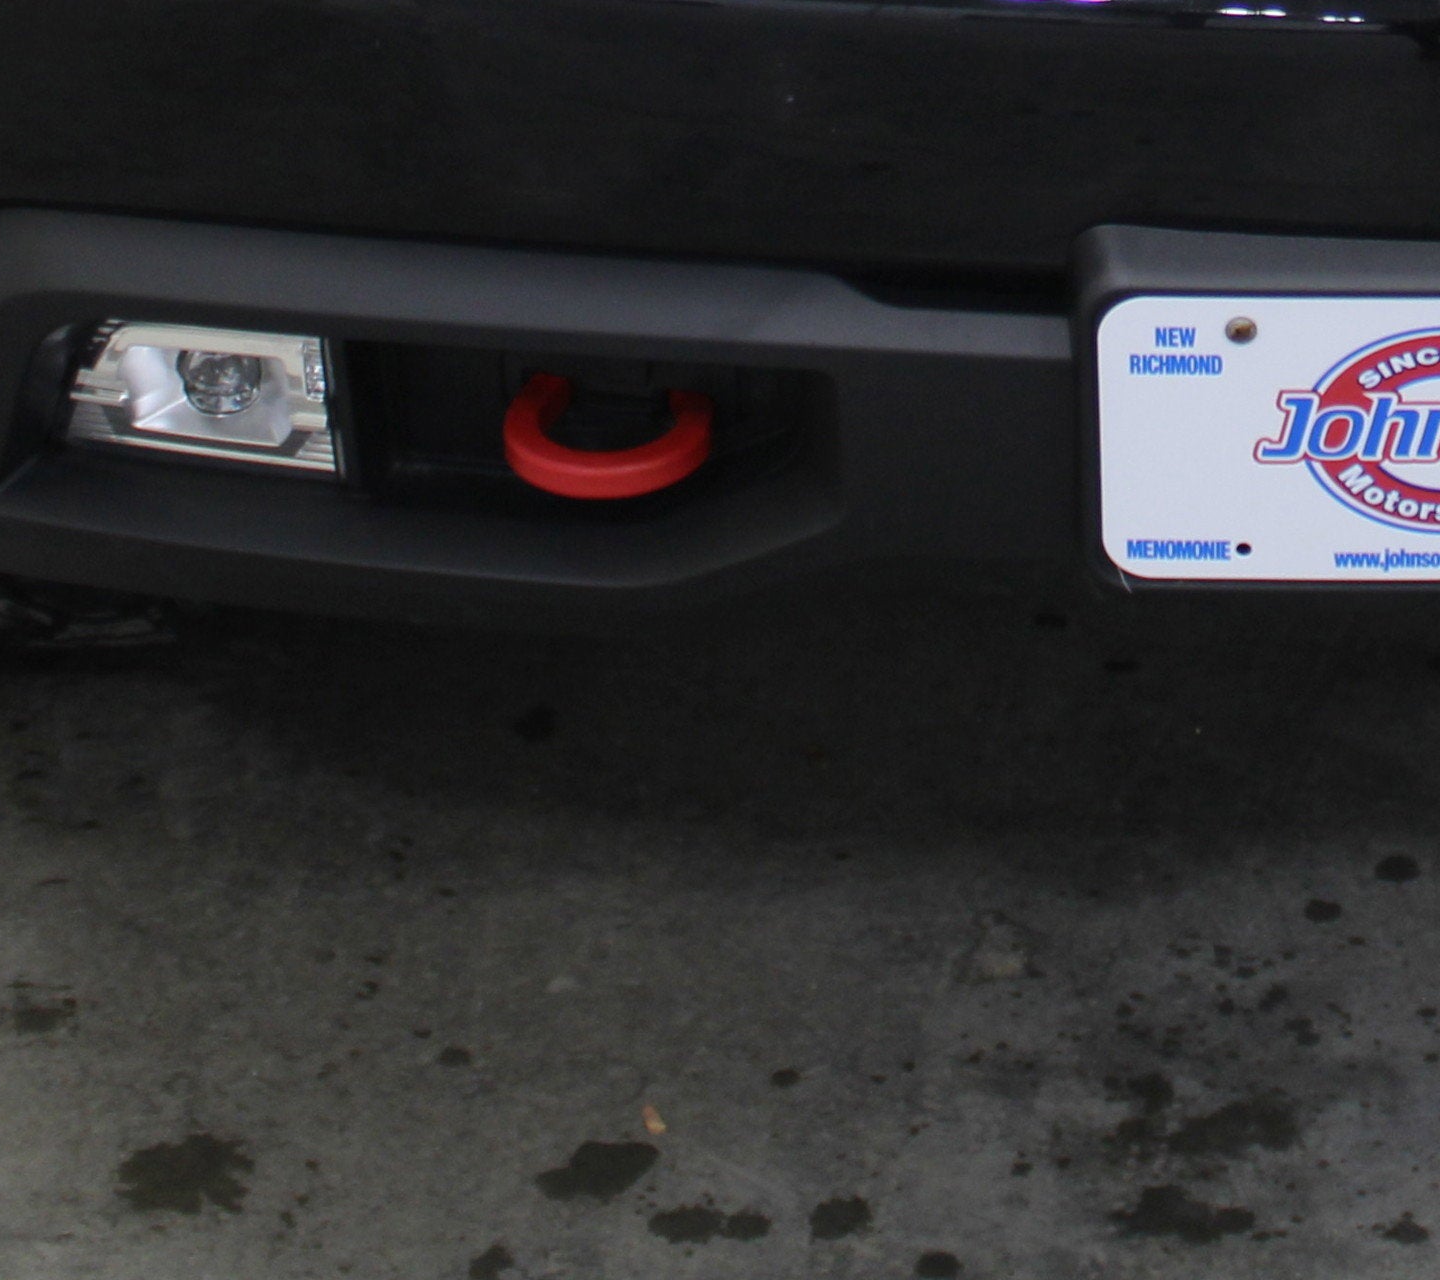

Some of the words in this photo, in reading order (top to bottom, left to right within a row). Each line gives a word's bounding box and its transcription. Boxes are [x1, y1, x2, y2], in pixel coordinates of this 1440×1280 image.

[1154, 326, 1196, 348] NEW
[1129, 354, 1223, 376] RICHMOND
[1126, 539, 1231, 561] MENOMONIE
